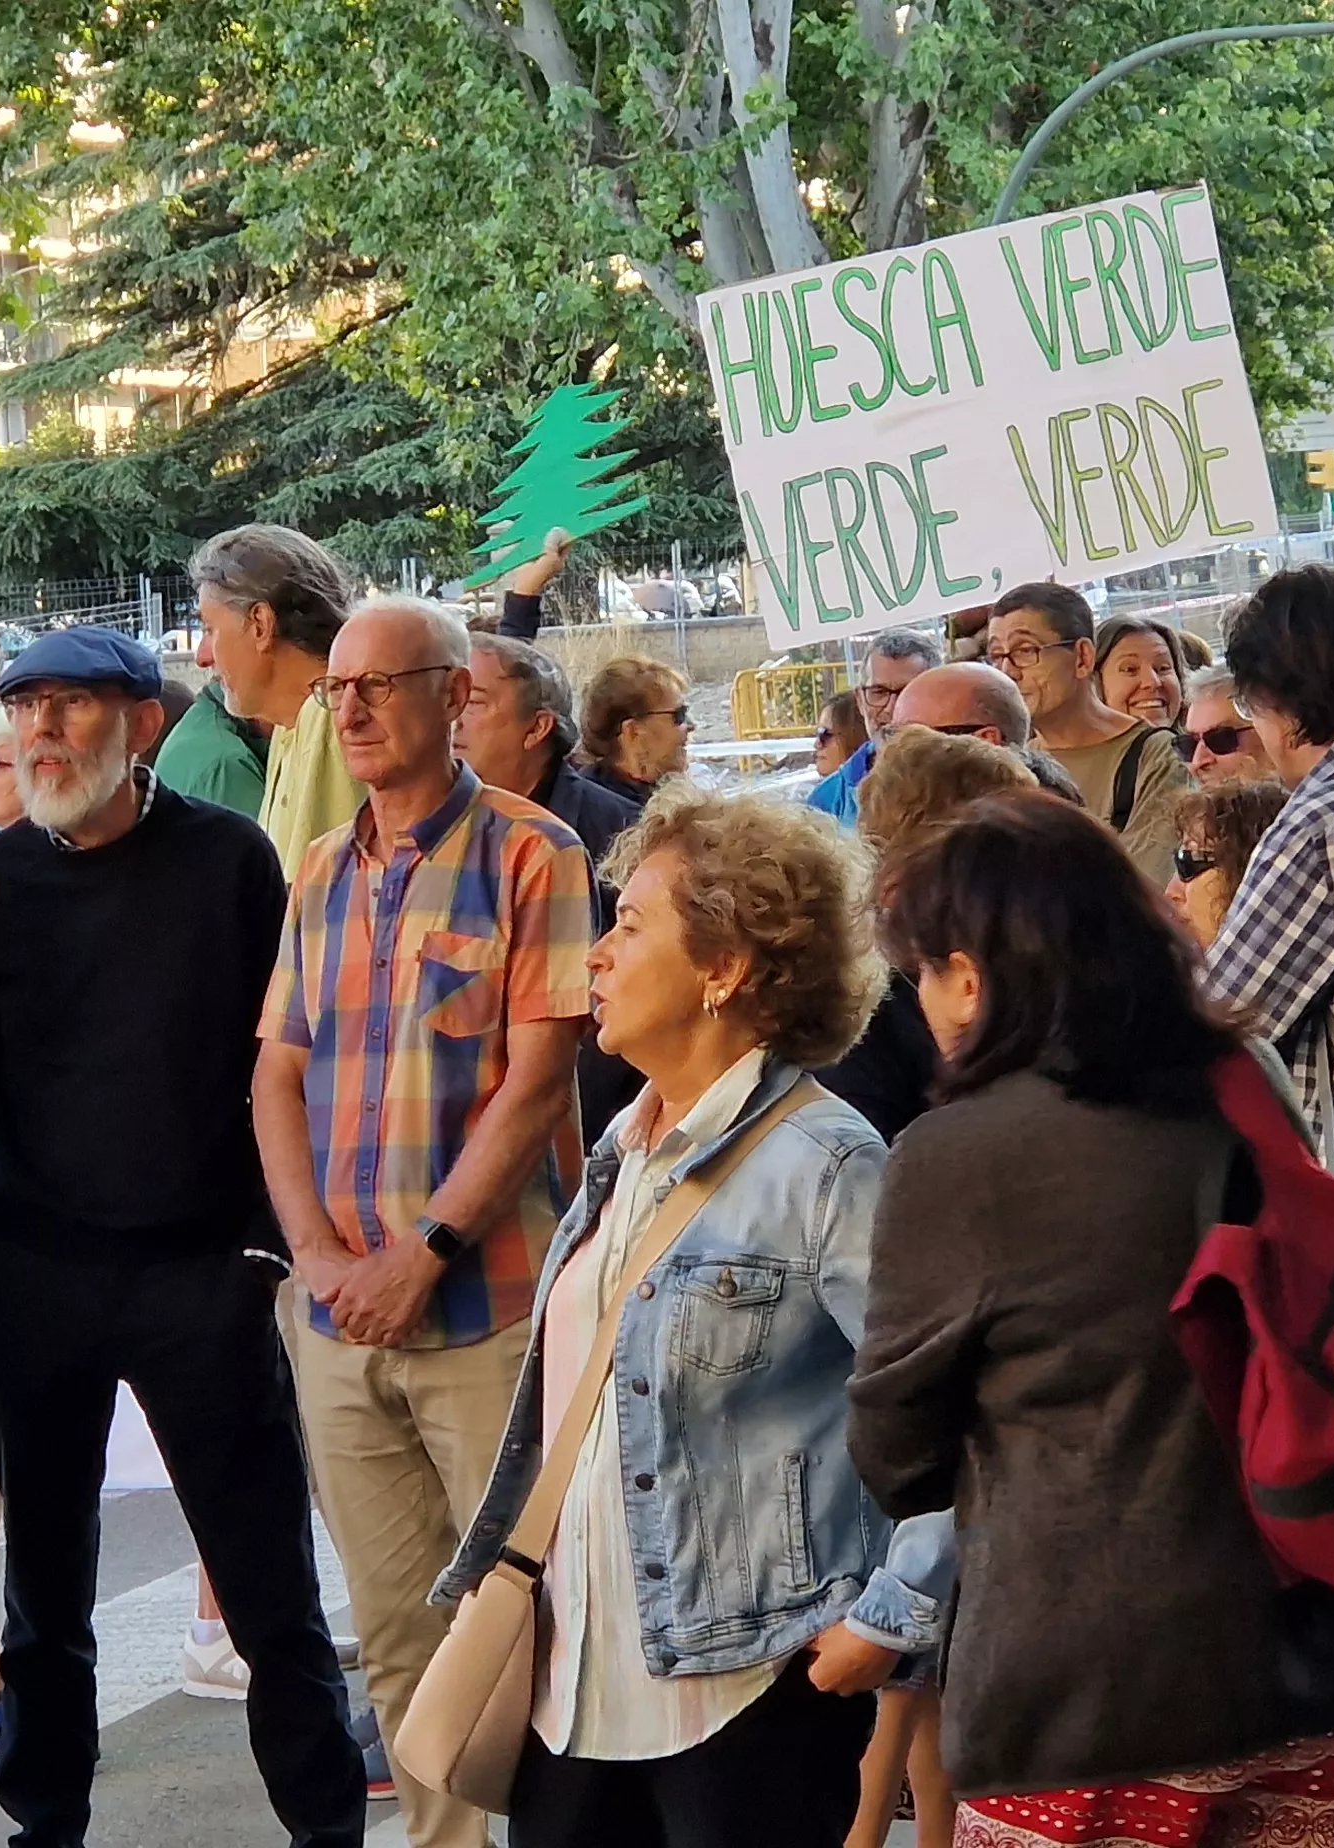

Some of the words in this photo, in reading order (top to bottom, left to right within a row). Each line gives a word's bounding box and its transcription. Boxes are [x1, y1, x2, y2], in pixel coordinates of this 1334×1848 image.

[709, 247, 985, 447] HUESCA
[1000, 187, 1231, 372] VERDE
[740, 444, 1003, 632] VERDE,
[1007, 378, 1255, 568] VERDE
